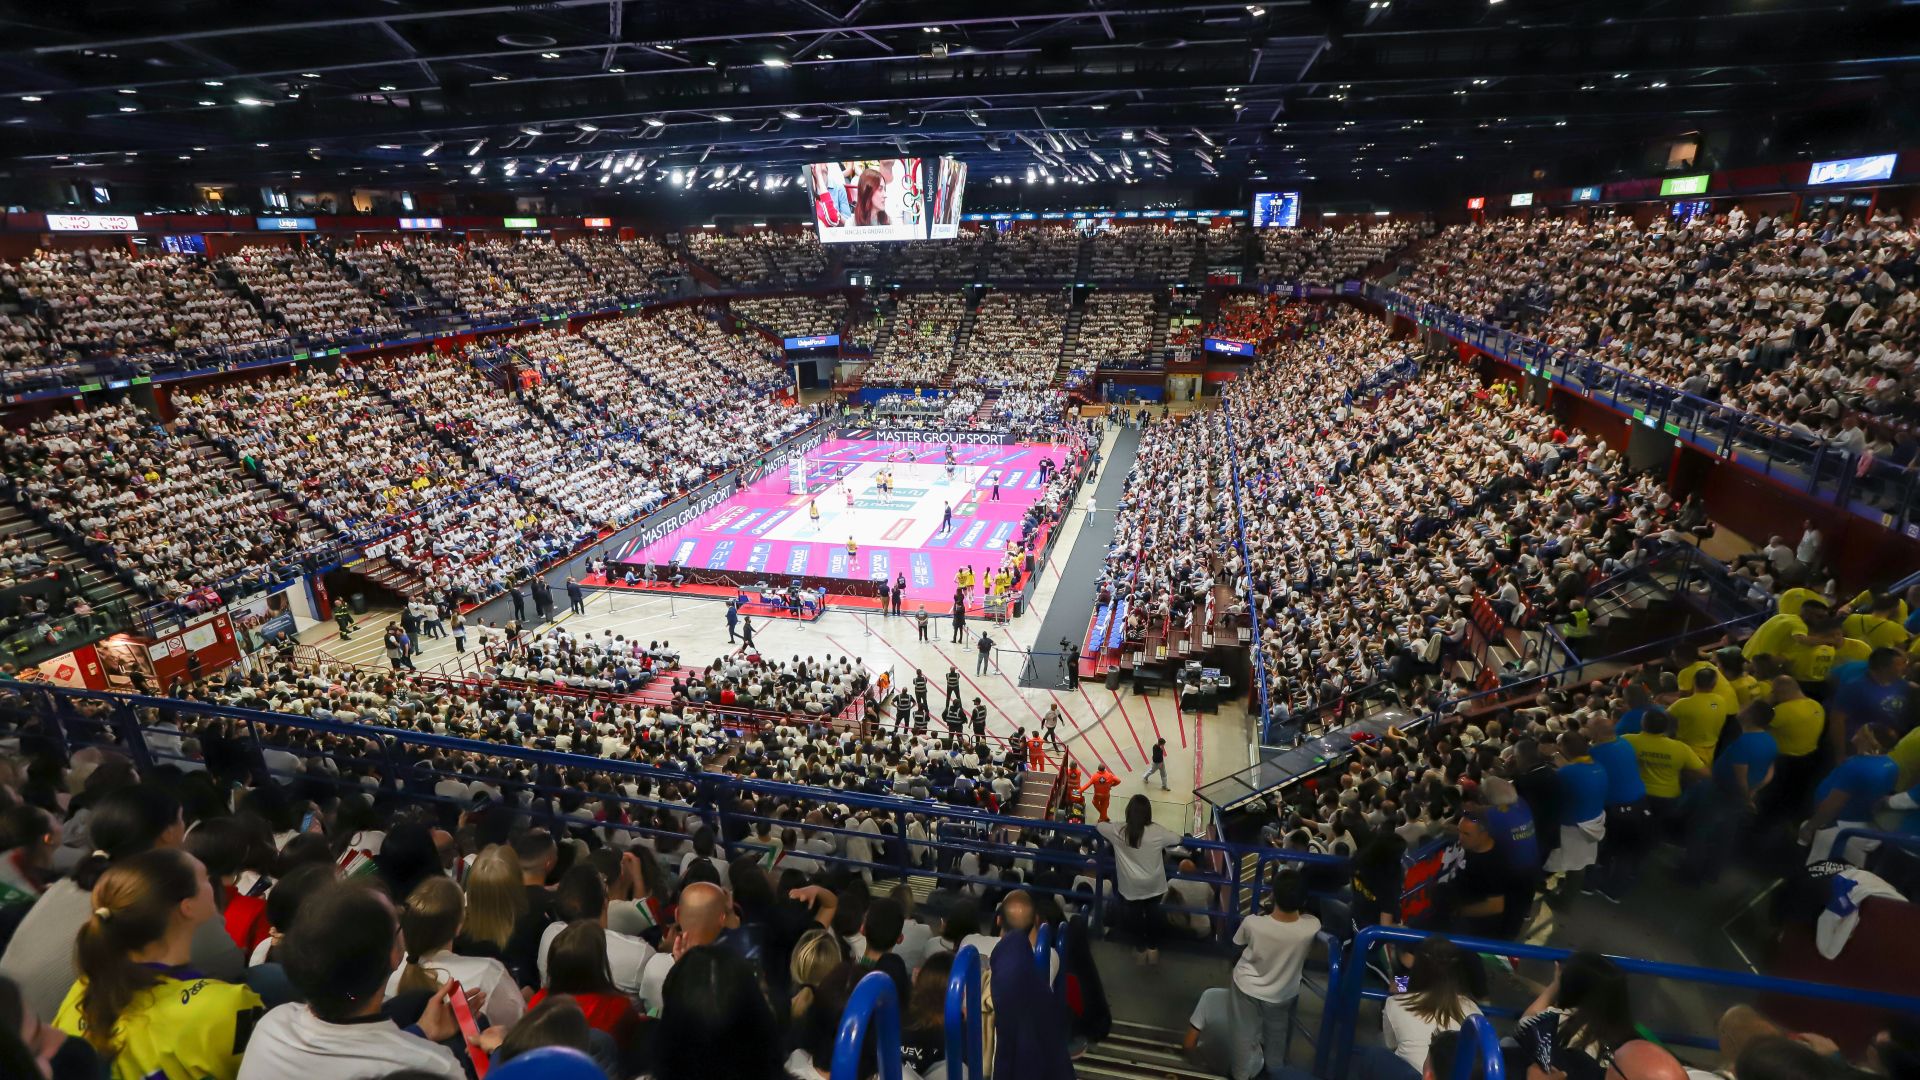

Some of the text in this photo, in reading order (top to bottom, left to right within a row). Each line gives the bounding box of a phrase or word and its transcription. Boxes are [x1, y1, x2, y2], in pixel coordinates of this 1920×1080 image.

[764, 454, 788, 475] MASTER
[806, 434, 821, 451] SPORT
[876, 430, 1006, 445] MASTER GROUP SPORT
[642, 485, 731, 547] MASTER GROUP SPORT
